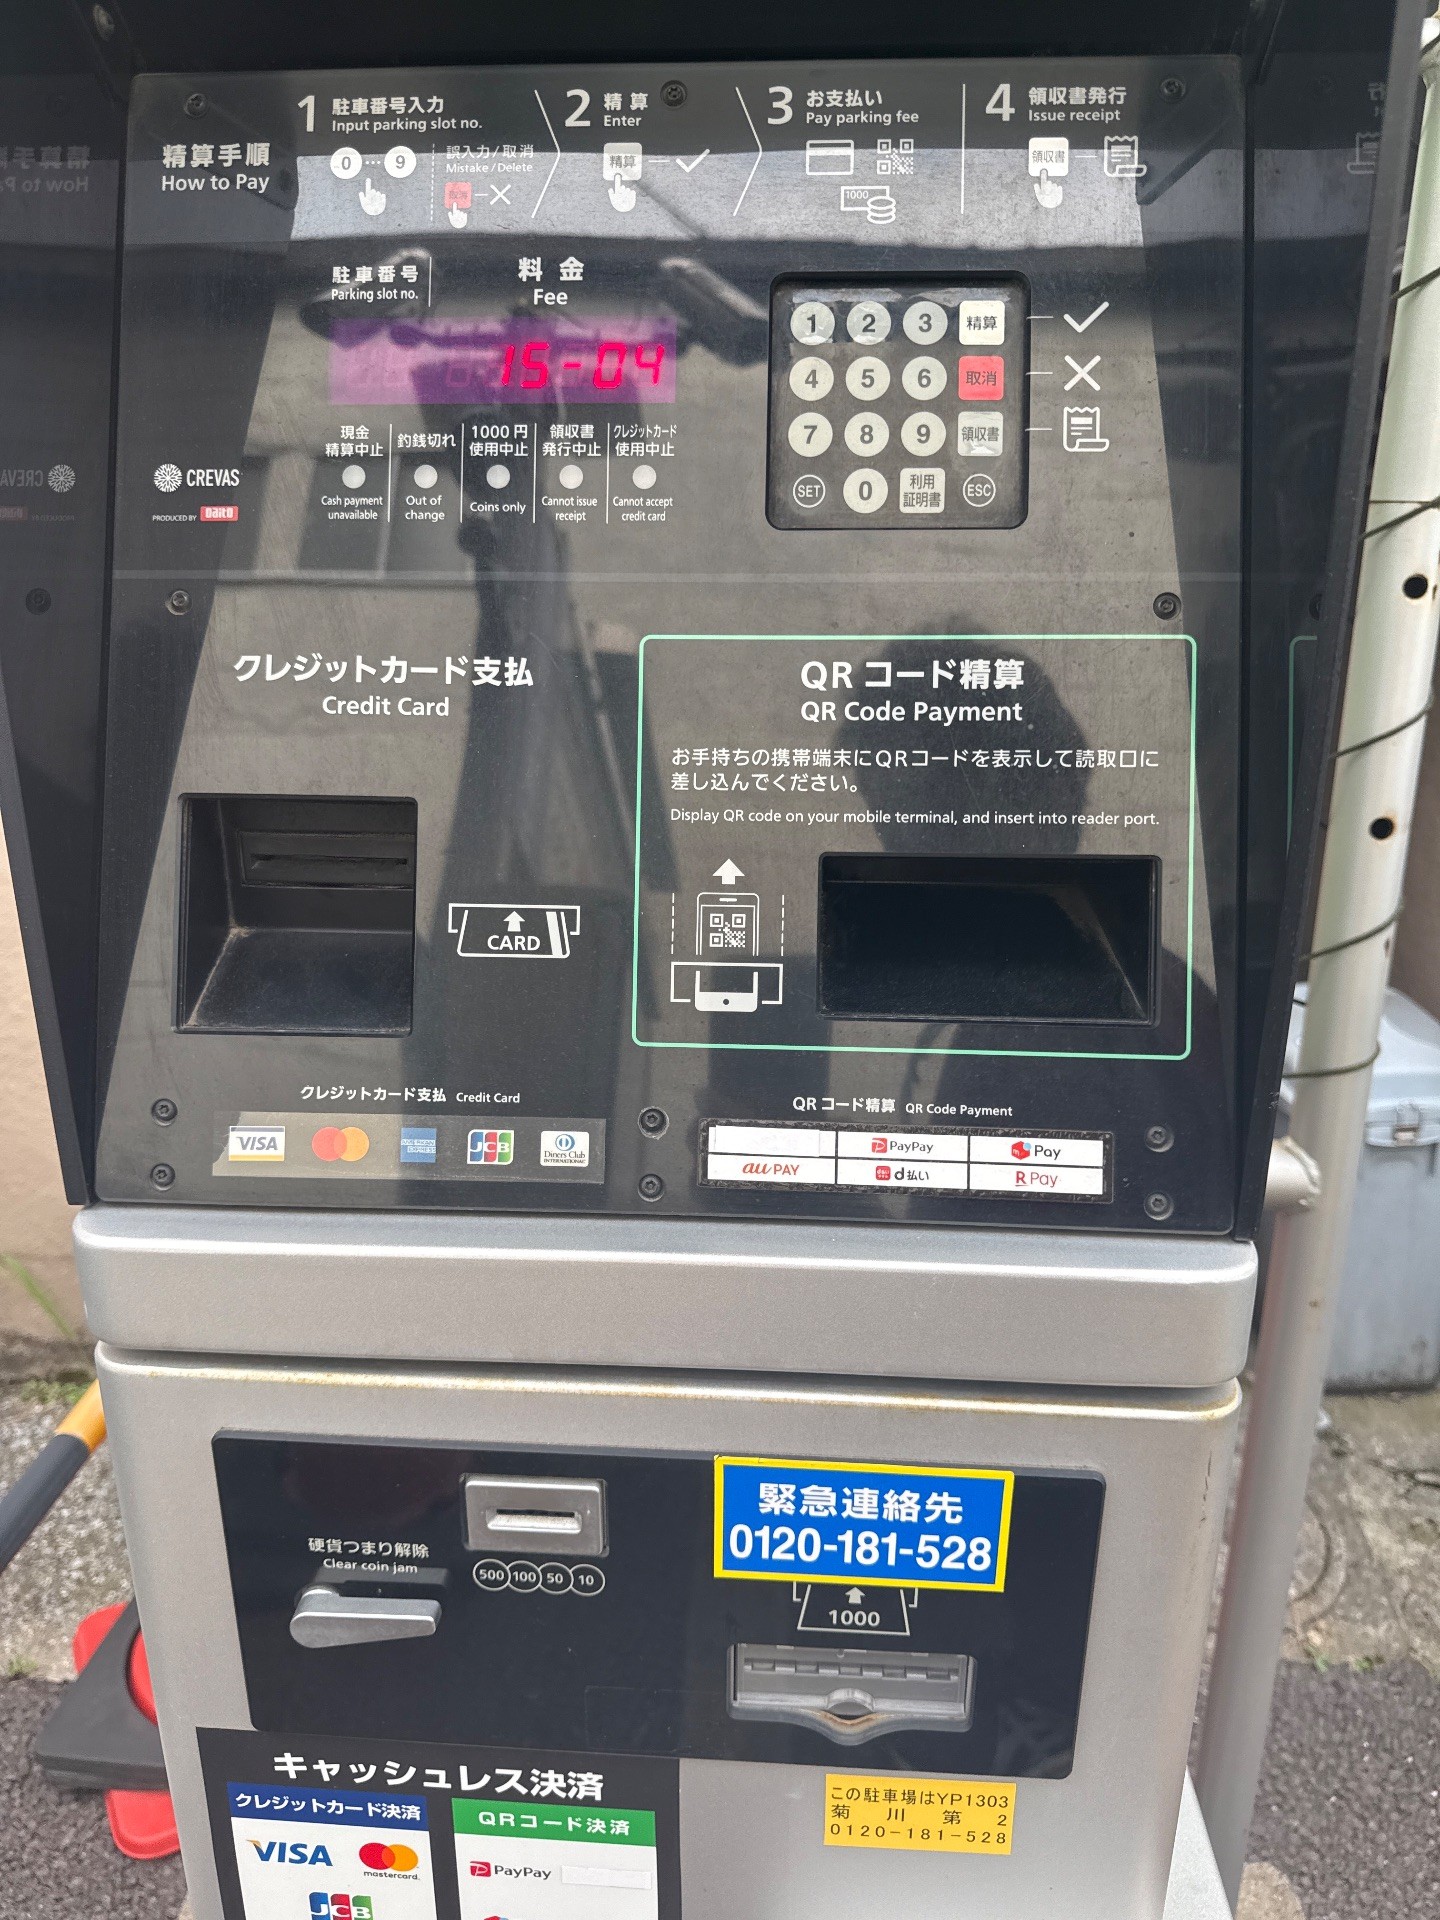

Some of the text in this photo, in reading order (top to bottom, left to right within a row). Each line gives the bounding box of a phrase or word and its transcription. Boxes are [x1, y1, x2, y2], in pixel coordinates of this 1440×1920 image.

[604, 91, 648, 112] 精算
[806, 89, 882, 108] お支払い
[985, 84, 1015, 121] 4
[1028, 87, 1127, 106] 領収書発行
[297, 95, 315, 132] 1
[332, 96, 444, 116] 駐車番号入力
[565, 89, 591, 127] 2
[767, 86, 793, 125] 3
[332, 115, 482, 134] Input parking slot no.
[604, 115, 641, 127] Enter
[806, 109, 919, 126] Pay parking fee
[1029, 109, 1121, 124] Issue receipt
[162, 142, 270, 168] 精算手順
[341, 155, 406, 171] 0 9
[609, 154, 637, 170] 精算
[1032, 149, 1065, 165] 領収書
[161, 174, 270, 194] How to Pay
[845, 190, 869, 200] 1000
[332, 265, 418, 283] 駐車番号
[518, 257, 585, 281] 料金
[331, 286, 419, 302] Parking slot no.
[533, 289, 568, 305] Fee
[806, 314, 817, 333] 1
[861, 314, 876, 333] 2
[918, 313, 932, 332] 3
[966, 315, 997, 330] 精算
[804, 370, 818, 388] 4
[861, 369, 875, 388] 5
[917, 369, 931, 388] 6
[965, 371, 997, 386] 取消
[340, 425, 369, 440] 現金
[550, 424, 594, 439] 領収書
[614, 424, 677, 438] クレジットカード
[803, 426, 818, 444] 7
[860, 425, 874, 444] 8
[916, 425, 930, 443] 9
[962, 427, 1000, 442] 領収書
[398, 433, 456, 448] 釣銭切れ
[615, 441, 675, 457] 使用中止
[325, 442, 384, 457] 精算中止
[469, 442, 528, 457] 使用中止
[542, 442, 601, 457] 発行中止
[186, 469, 240, 487] CREVAS
[909, 474, 935, 489] 利用
[798, 485, 821, 498] SET
[858, 481, 873, 500] 0
[967, 484, 991, 497] ESC
[321, 495, 383, 509] Cash payment
[406, 495, 443, 506] Out of
[541, 496, 598, 507] Cannot issue
[612, 496, 673, 510] Cannot accept
[903, 492, 941, 508] 証明書
[328, 509, 378, 520] unavailable
[405, 509, 445, 523] change
[470, 502, 526, 516] Coins only
[555, 510, 586, 523] receipt
[621, 510, 666, 521] credit card
[234, 653, 534, 687] クレジットカード支払
[322, 696, 450, 716] Credit Card
[801, 701, 1022, 726] QR Code Payment
[671, 747, 1160, 769] お手持ちの携帯端末にQRコードを表示して読取口に
[670, 772, 858, 793] 差し込んでください。
[670, 809, 1160, 827] Display QR code on your mobile terminal, and insert into reader port.
[487, 935, 541, 951] CARD
[300, 1084, 446, 1102] クレジットカード支払
[456, 1092, 520, 1103] Credit Card
[905, 1103, 1013, 1119] QR Code Payment
[236, 1136, 278, 1151] VISA
[890, 1140, 933, 1154] PayPay
[1035, 1144, 1061, 1160] Pay
[544, 1150, 586, 1159] Diners Club
[742, 1162, 800, 1175] au PAY
[894, 1167, 929, 1181] d払い
[1030, 1172, 1058, 1188] Pay
[758, 1482, 963, 1525] 緊急連絡先
[308, 1537, 429, 1559] 硬貨つまり解除
[729, 1524, 992, 1572] 0120-181-528
[323, 1558, 418, 1575] Clear coin jam
[479, 1569, 594, 1586] 500 100 50 10
[828, 1609, 880, 1627] 1000
[273, 1752, 604, 1802] キャッシュレス決済
[831, 1786, 1009, 1809] この駐車場はYP1303
[236, 1793, 423, 1821] クレジットカード決済
[478, 1810, 631, 1837] QRコード決済
[830, 1823, 1006, 1845] 0120-181-528
[246, 1839, 333, 1867] VISA
[494, 1865, 551, 1880] PayPay
